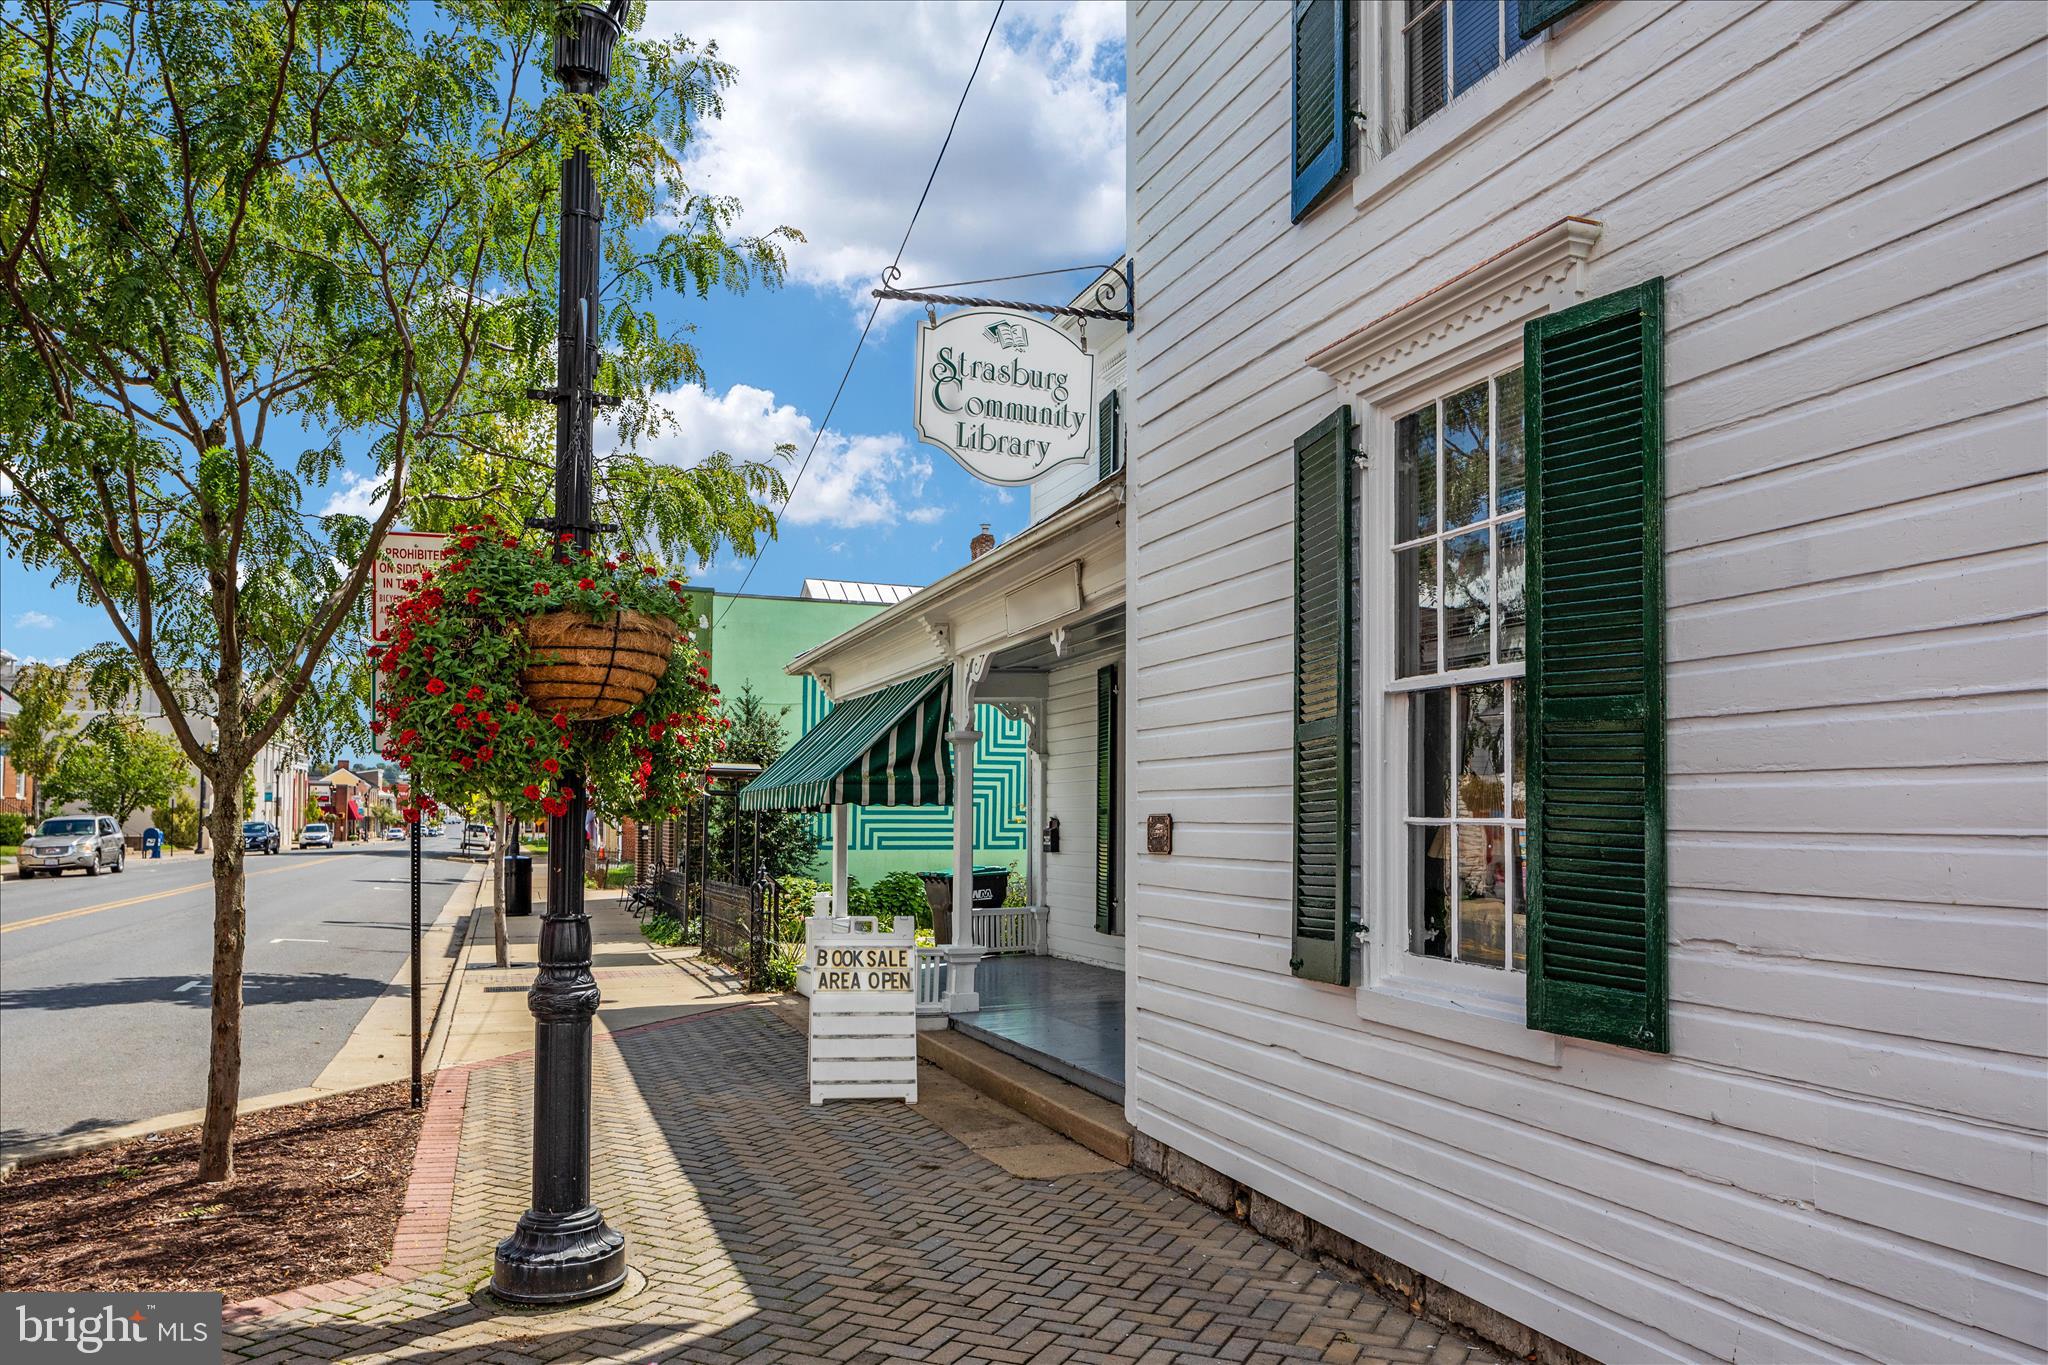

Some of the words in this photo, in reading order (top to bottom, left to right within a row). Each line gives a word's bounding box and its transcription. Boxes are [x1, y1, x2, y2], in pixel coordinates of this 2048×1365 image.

[931, 347, 1069, 402] Strasburg
[932, 376, 1087, 440] Community
[955, 422, 1052, 469] Library
[379, 562, 394, 574] ON
[383, 577, 393, 589] IN
[817, 949, 864, 967] BOOK
[867, 950, 908, 967] SALE
[818, 972, 861, 989] AREA
[868, 972, 911, 989] OPEN
